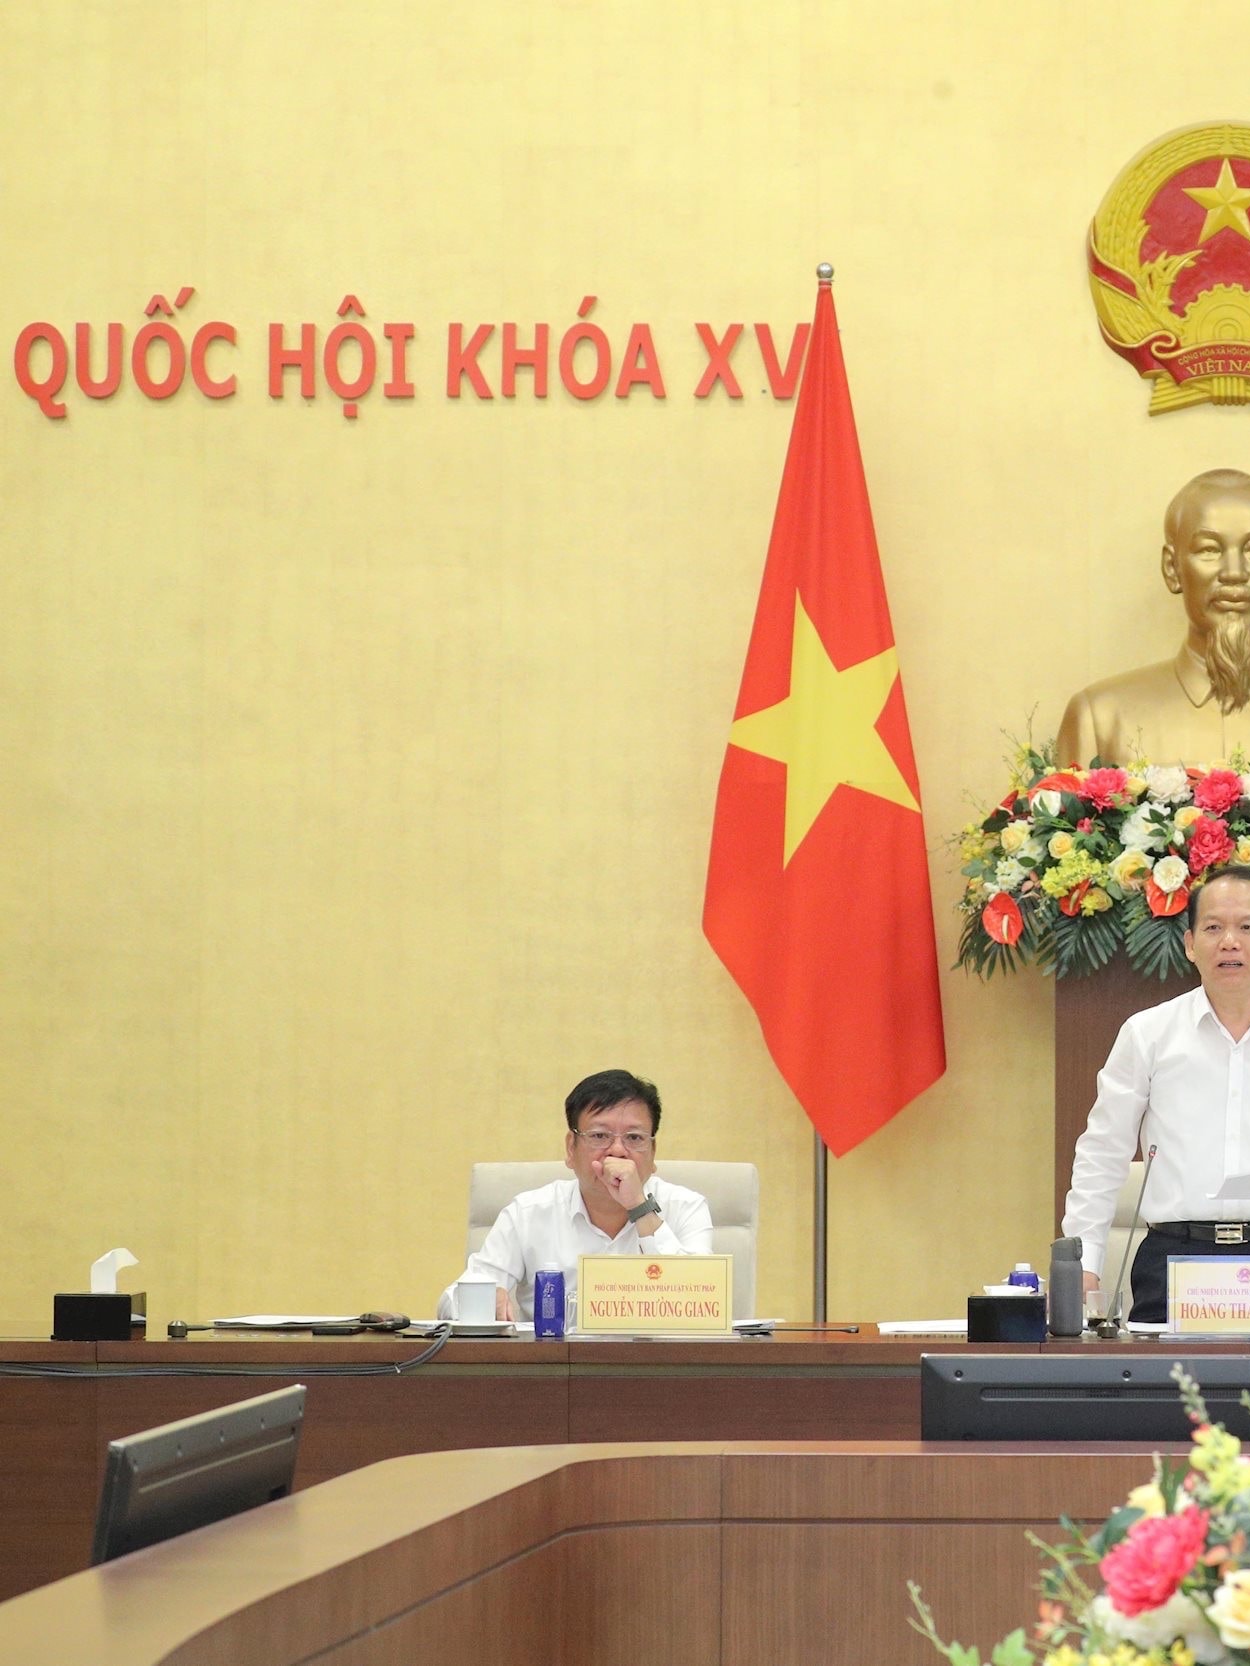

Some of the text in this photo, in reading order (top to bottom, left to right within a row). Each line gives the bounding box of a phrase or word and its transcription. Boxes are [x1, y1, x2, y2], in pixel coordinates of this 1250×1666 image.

[13, 287, 811, 418] QUỐC HỘI KHÓA XV
[1178, 352, 1198, 365] CỘNG
[1186, 358, 1226, 376] VIỆT
[589, 1296, 720, 1318] NGUYỄN TRƯỜNG GIANG
[1180, 1297, 1226, 1320] HOÀNG
